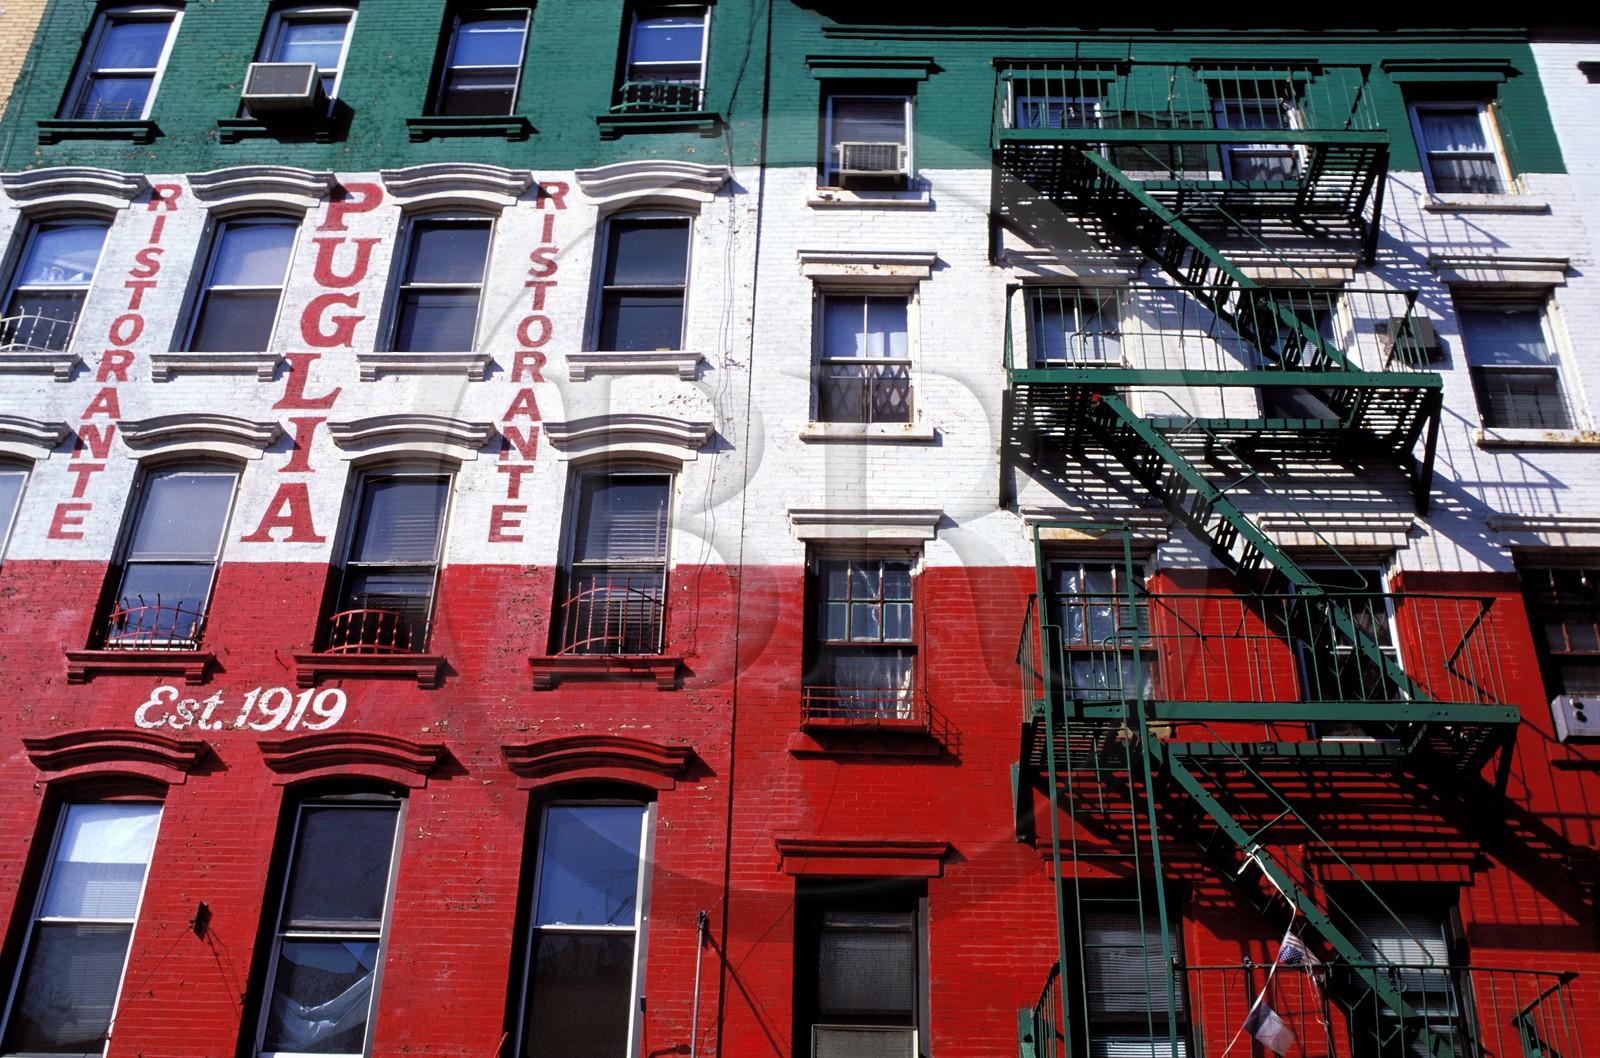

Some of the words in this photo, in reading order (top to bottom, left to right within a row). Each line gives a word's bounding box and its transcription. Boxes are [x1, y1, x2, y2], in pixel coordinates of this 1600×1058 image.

[47, 183, 182, 541] RISTORANTE
[240, 182, 384, 544] PUGLIA
[487, 181, 570, 544] RISTORANTE
[134, 685, 223, 731] Est.
[233, 686, 347, 732] 1919
